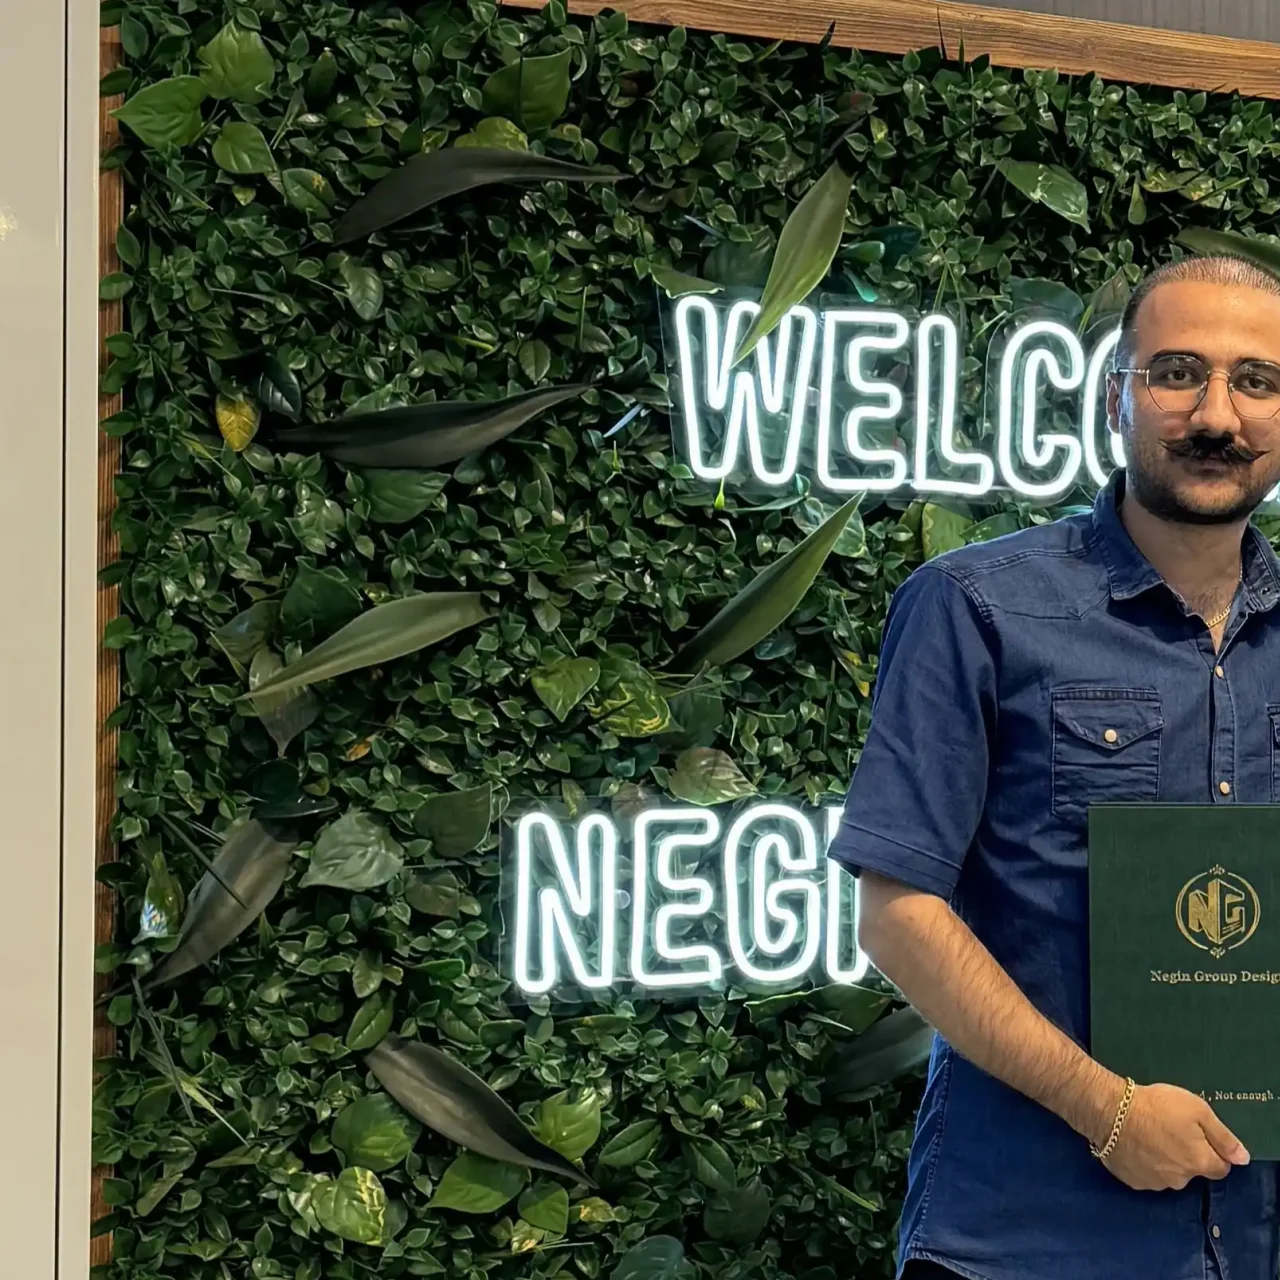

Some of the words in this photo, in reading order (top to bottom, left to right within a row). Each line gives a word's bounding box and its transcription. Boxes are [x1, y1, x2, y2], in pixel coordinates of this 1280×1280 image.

[513, 803, 871, 994] NEGI
[1150, 970, 1192, 984] Negin
[1194, 970, 1238, 985] Group
[1215, 1090, 1234, 1100] Not
[1236, 1089, 1275, 1102] enough
